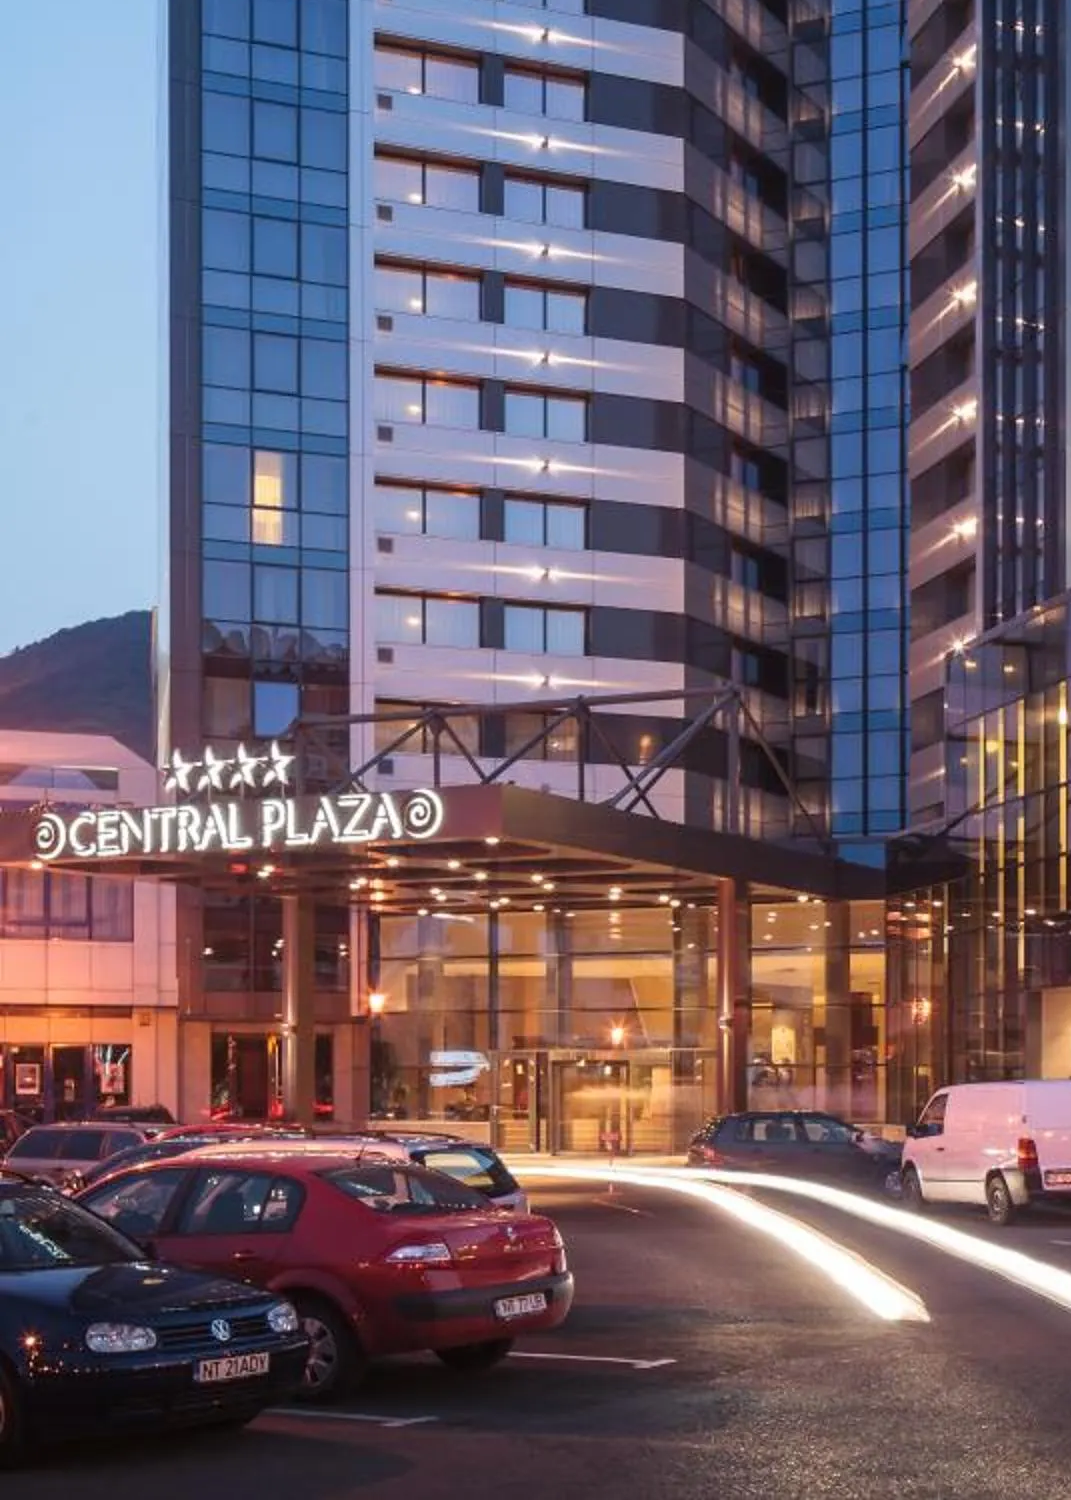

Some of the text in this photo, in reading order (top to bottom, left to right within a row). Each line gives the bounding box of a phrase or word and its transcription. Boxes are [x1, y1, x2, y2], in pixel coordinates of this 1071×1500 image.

[68, 792, 403, 858] CENTRAL PLAZA
[203, 1361, 221, 1379] NT
